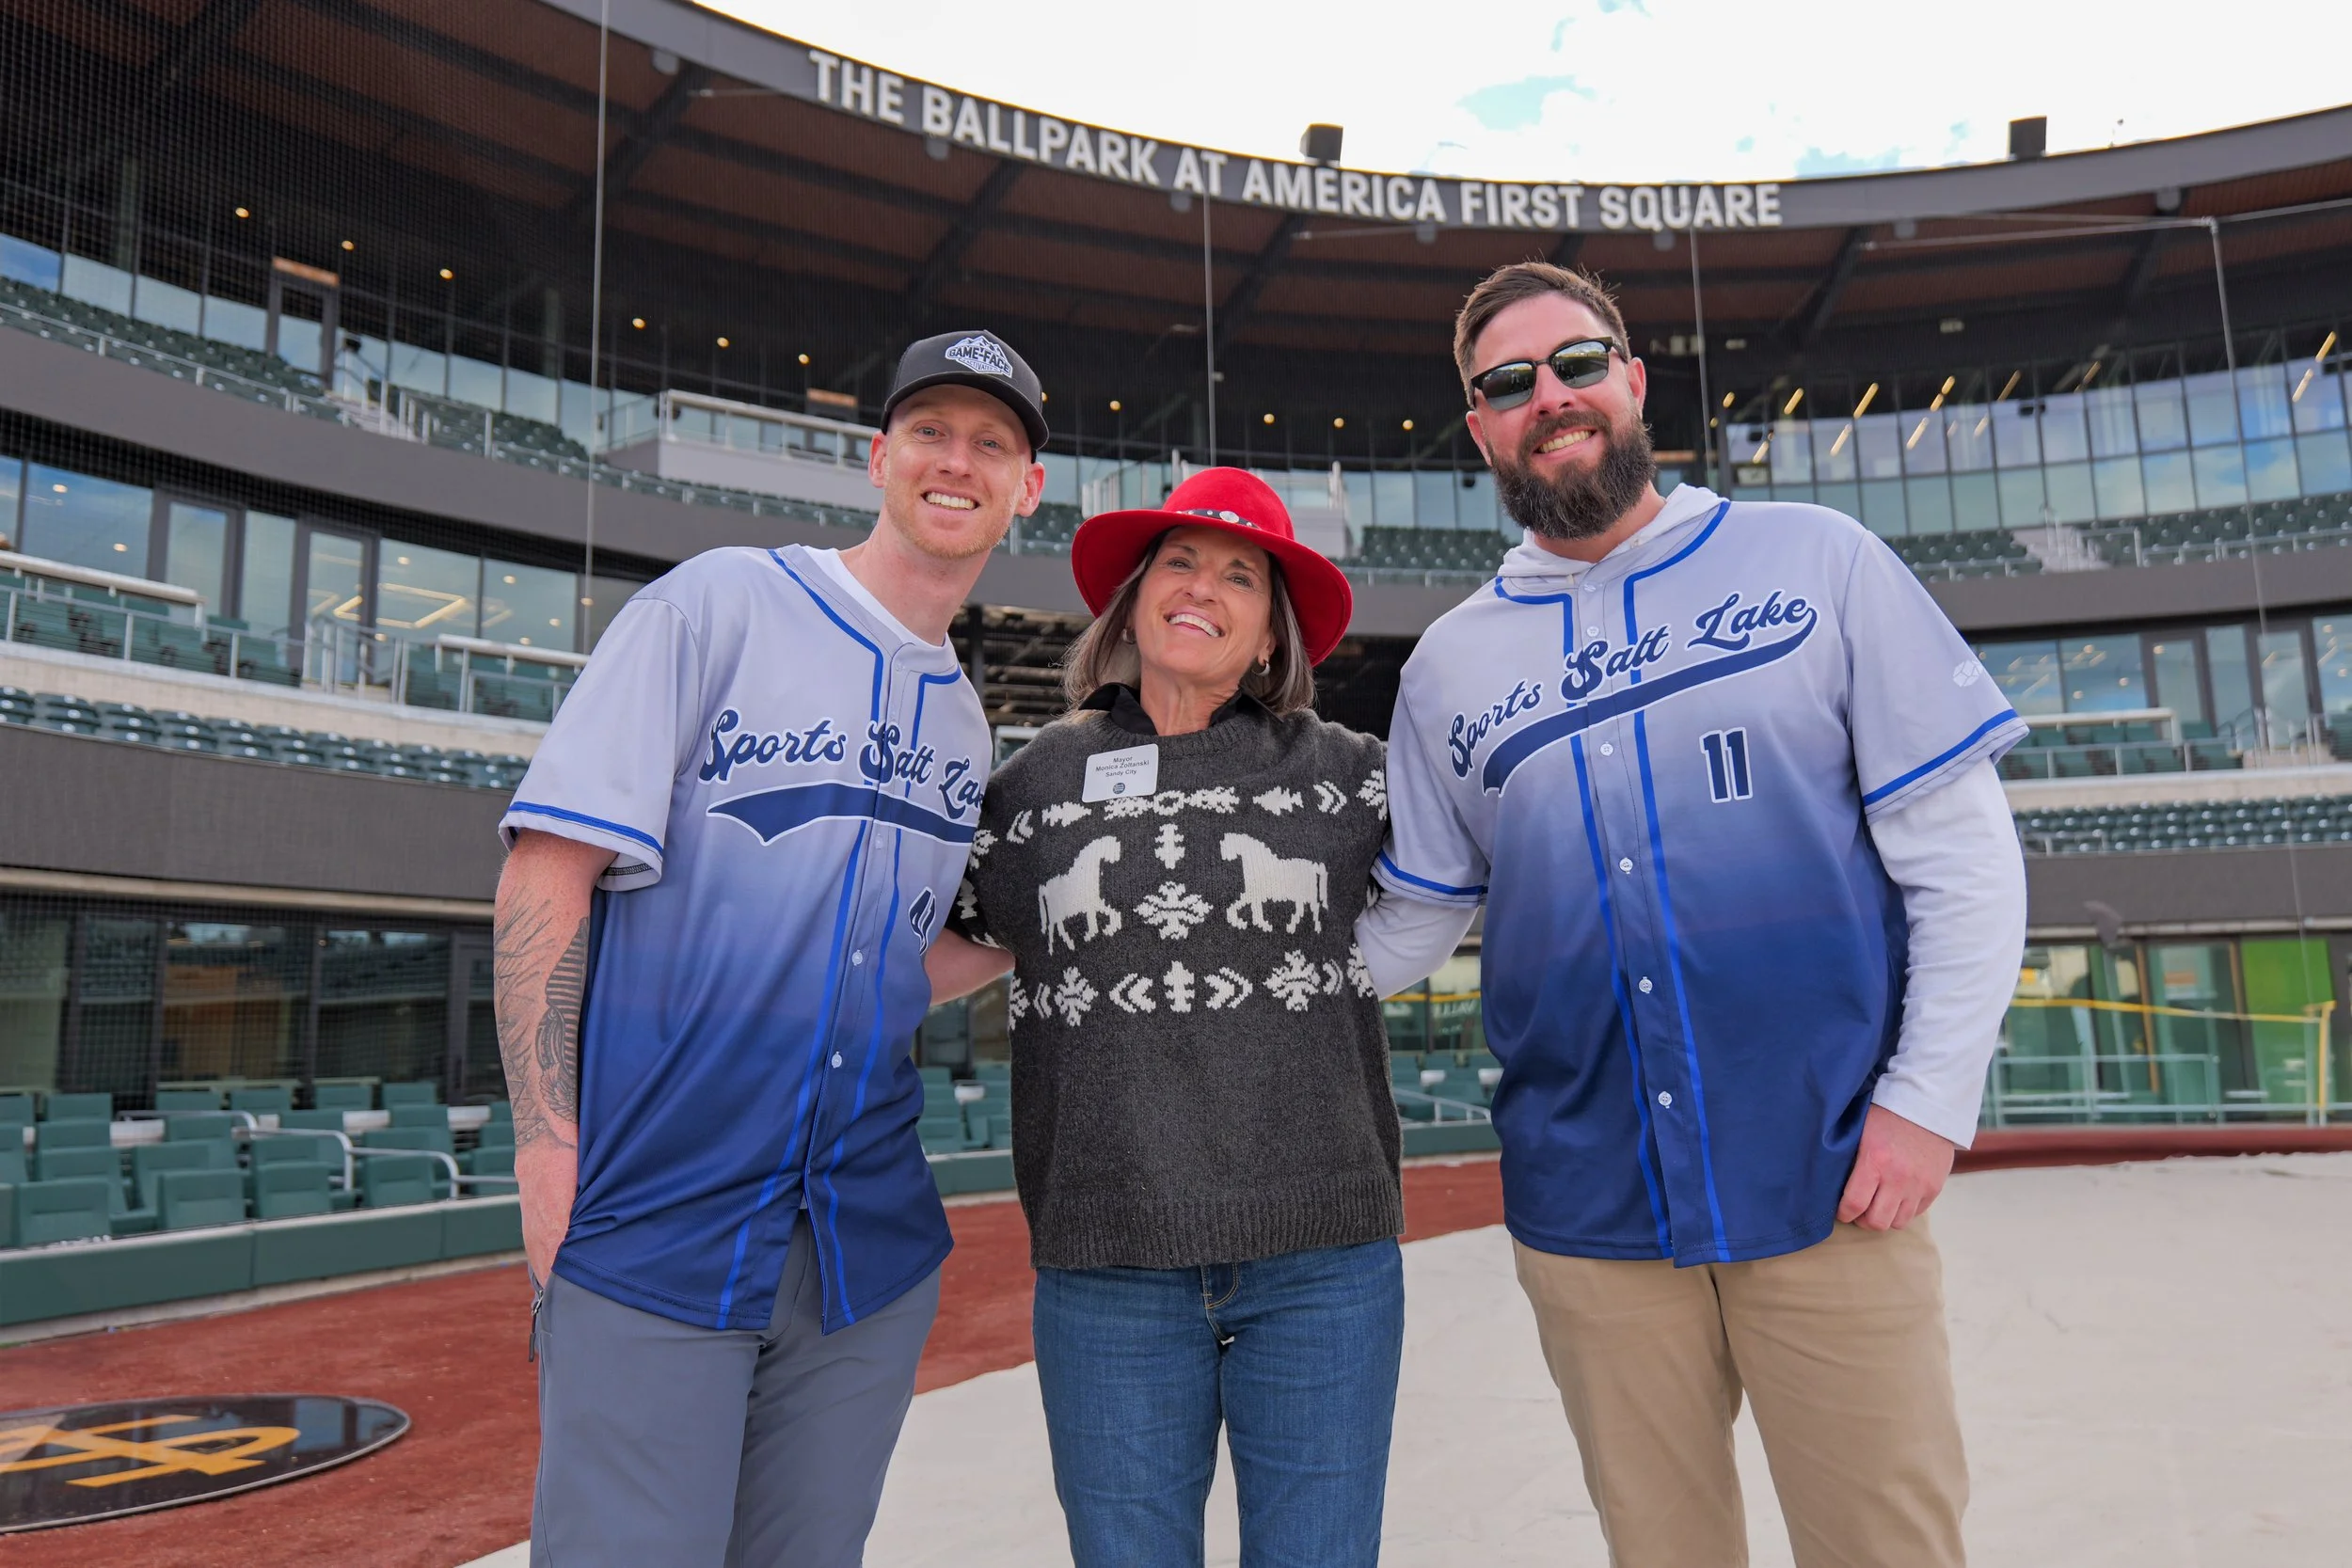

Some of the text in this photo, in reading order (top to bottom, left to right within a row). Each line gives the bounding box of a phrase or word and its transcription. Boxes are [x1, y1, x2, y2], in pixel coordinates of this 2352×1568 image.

[810, 50, 1782, 231] THE BALLPARK AT AMERICA FIRST SQUARE
[1448, 589, 1809, 781] Sports Salt Lake
[698, 708, 984, 820] Sports Salt La
[1095, 764, 1118, 772] Monica
[1699, 727, 1753, 803] 11
